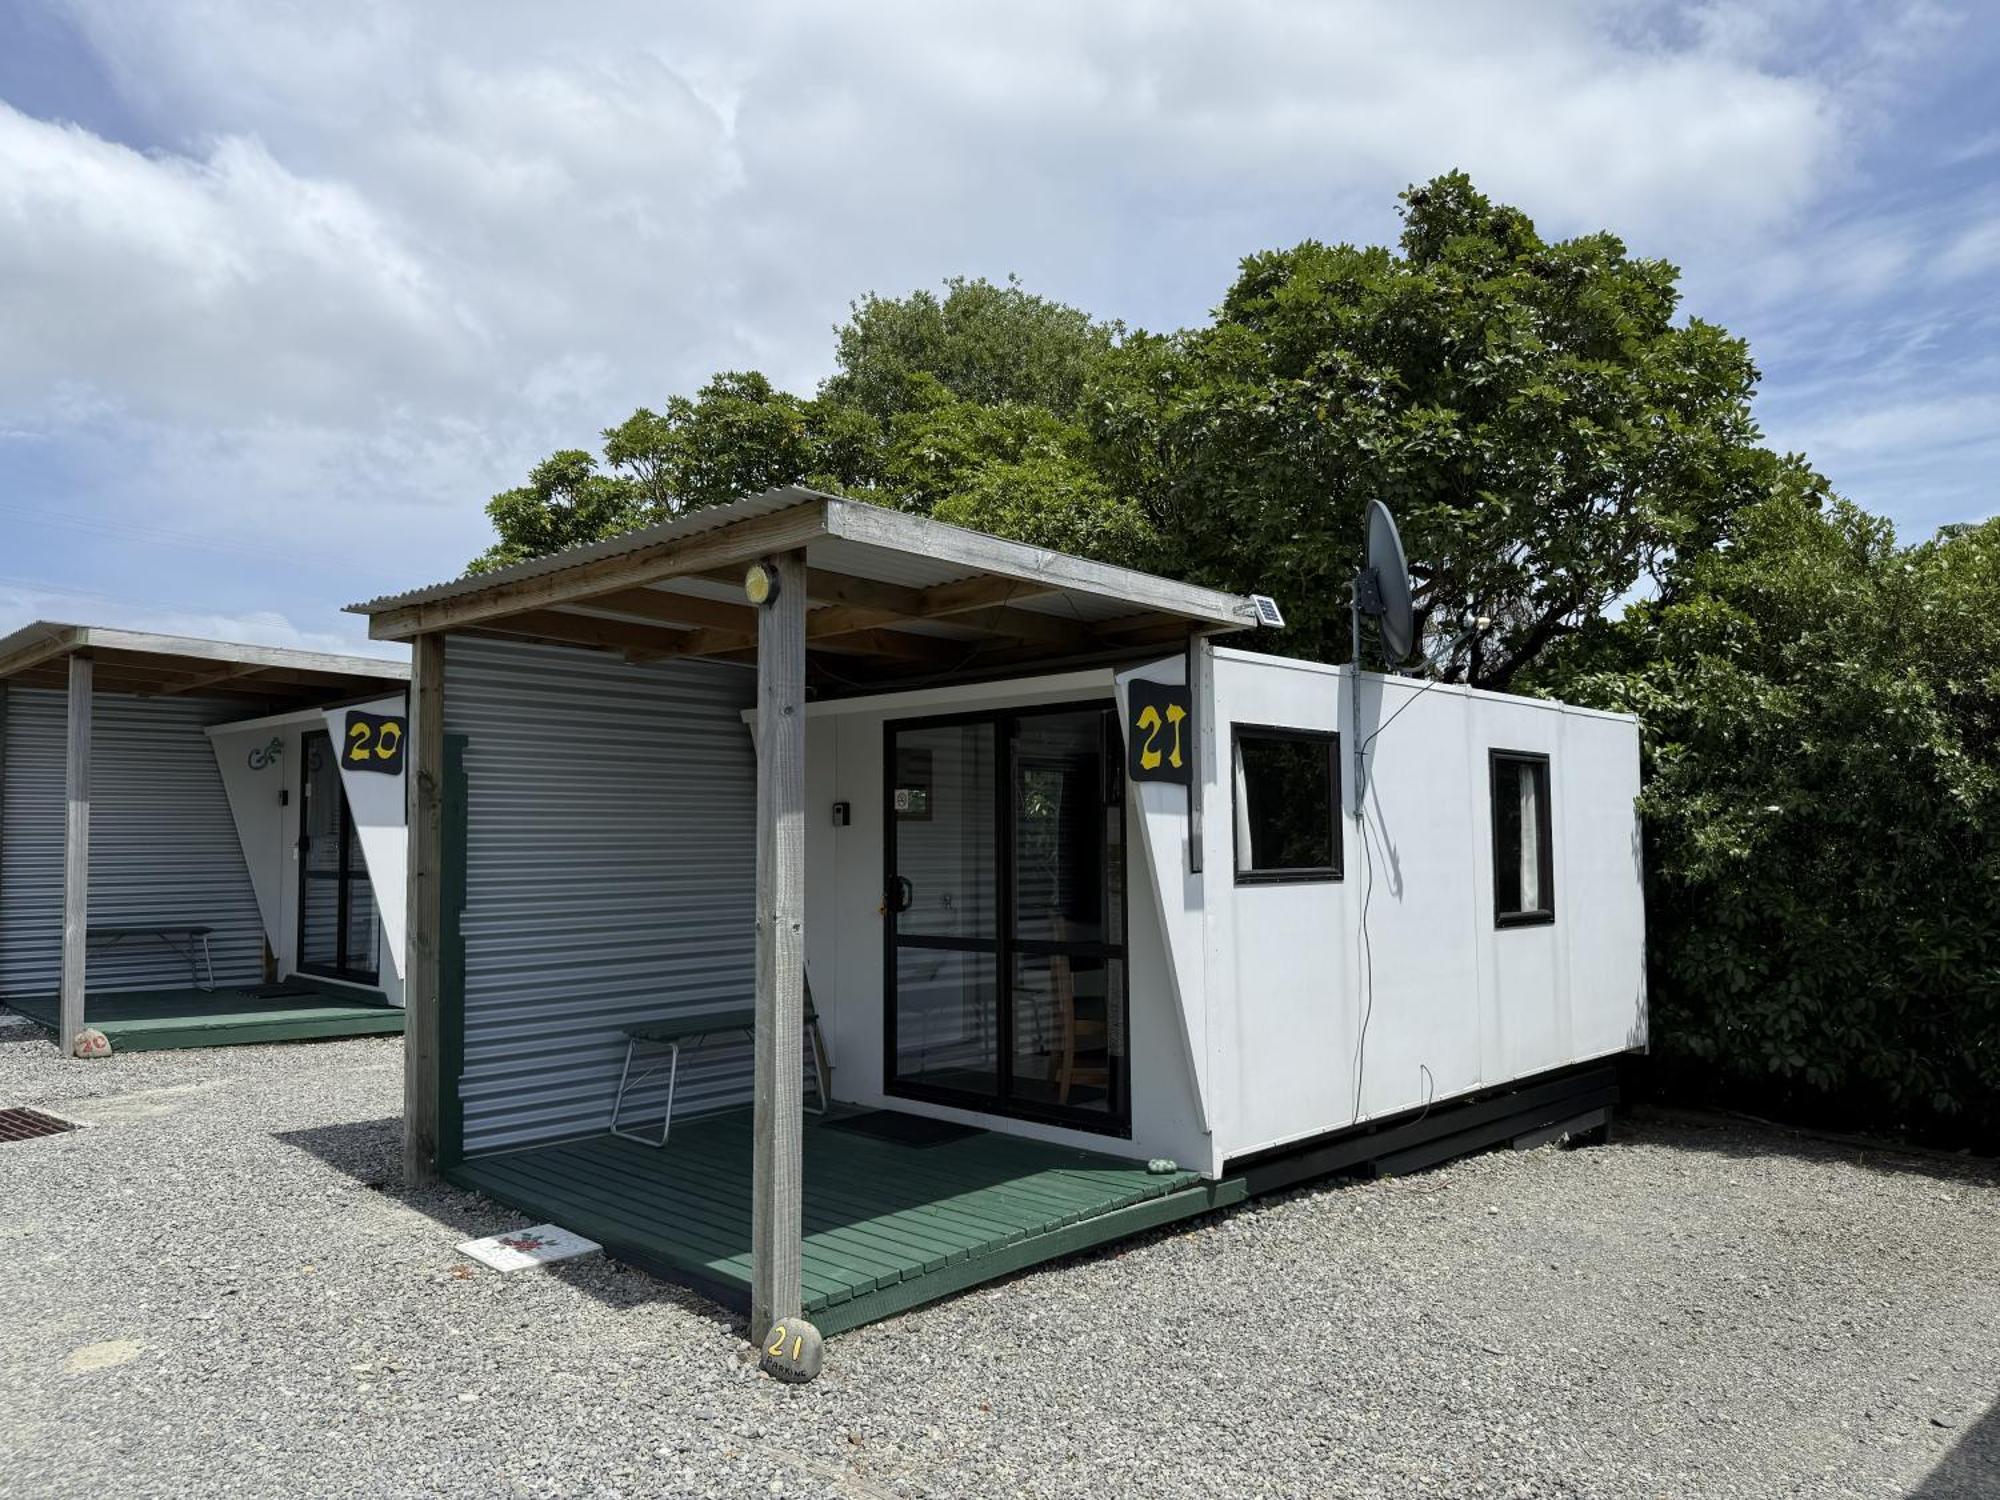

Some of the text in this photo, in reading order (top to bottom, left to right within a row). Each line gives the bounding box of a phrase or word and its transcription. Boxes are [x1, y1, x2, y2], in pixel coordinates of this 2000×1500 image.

[349, 722, 401, 760] 20
[1136, 704, 1186, 769] 21
[80, 1035, 107, 1052] 20
[768, 1326, 802, 1361] 21
[766, 1355, 808, 1377] PARKING
